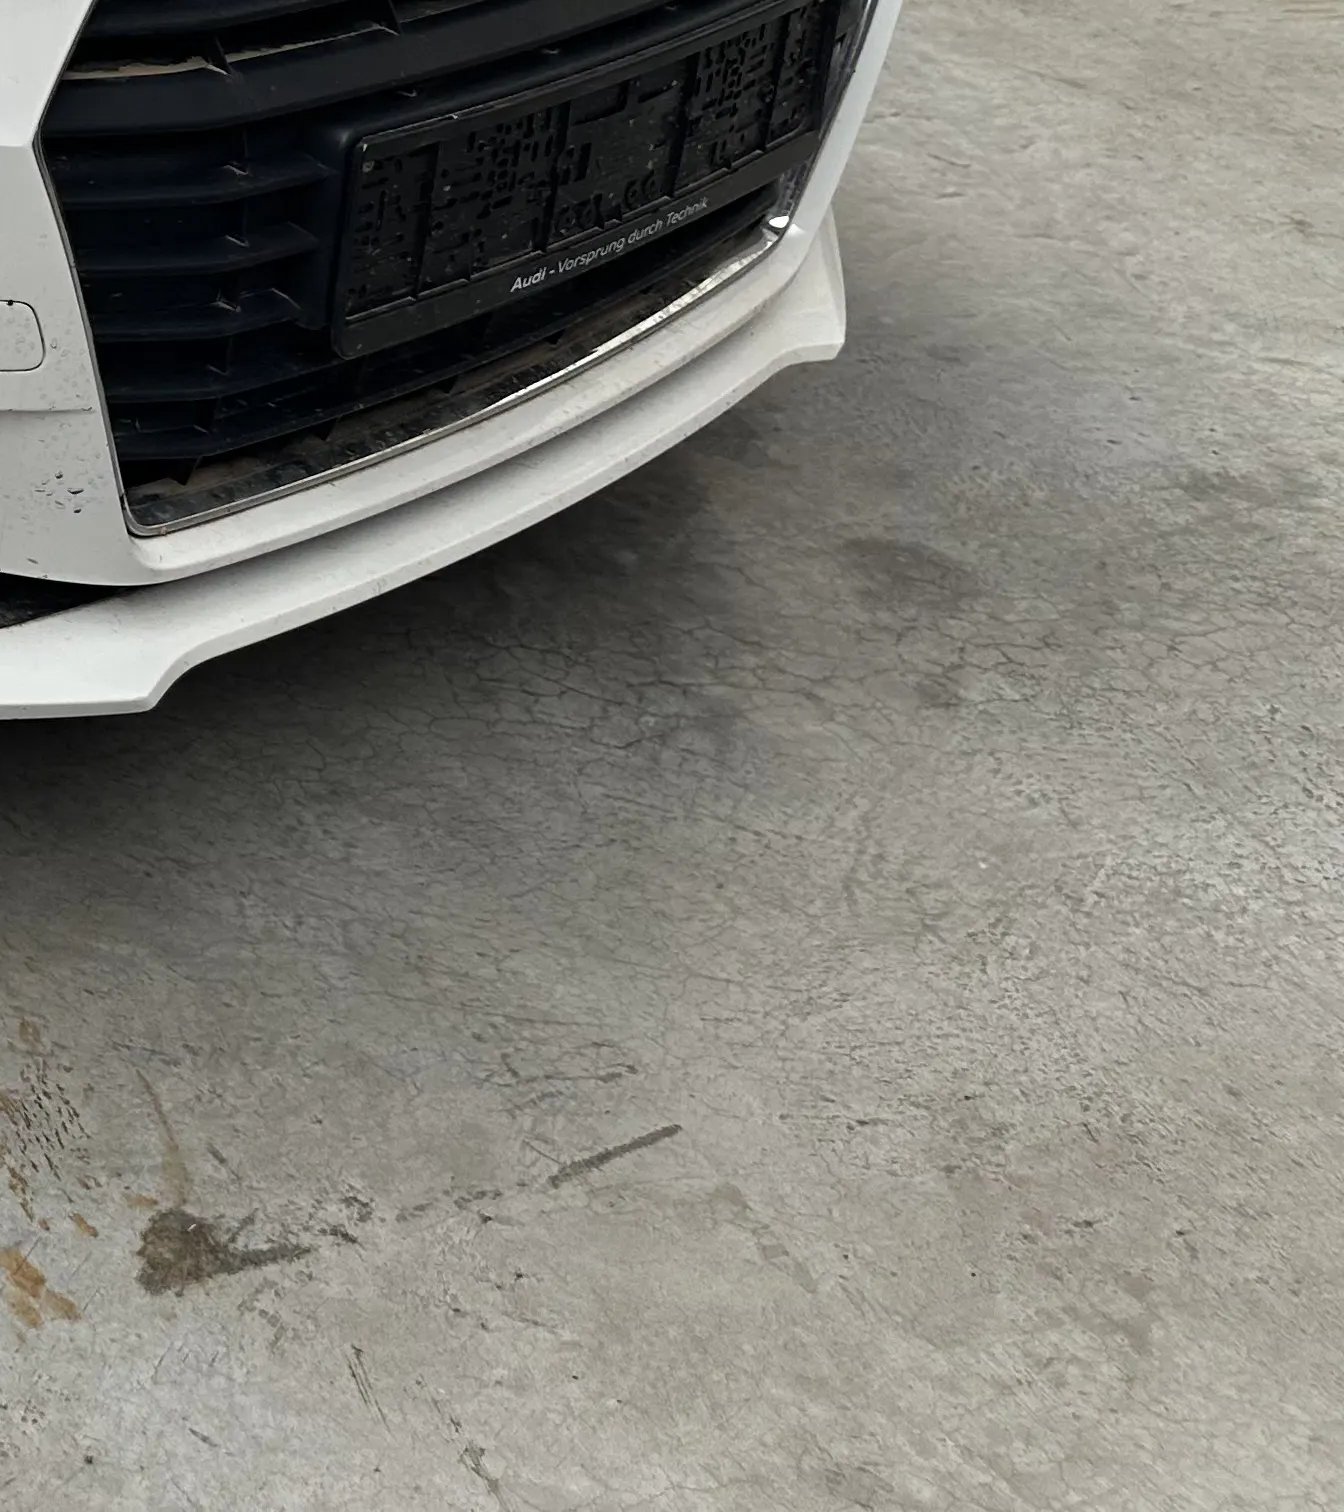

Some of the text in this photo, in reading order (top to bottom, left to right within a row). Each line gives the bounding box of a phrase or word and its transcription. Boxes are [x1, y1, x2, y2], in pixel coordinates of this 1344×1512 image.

[510, 266, 547, 293] Audi
[558, 237, 626, 274] Vorsprung
[627, 219, 663, 244] durch
[666, 196, 708, 226] Technik
